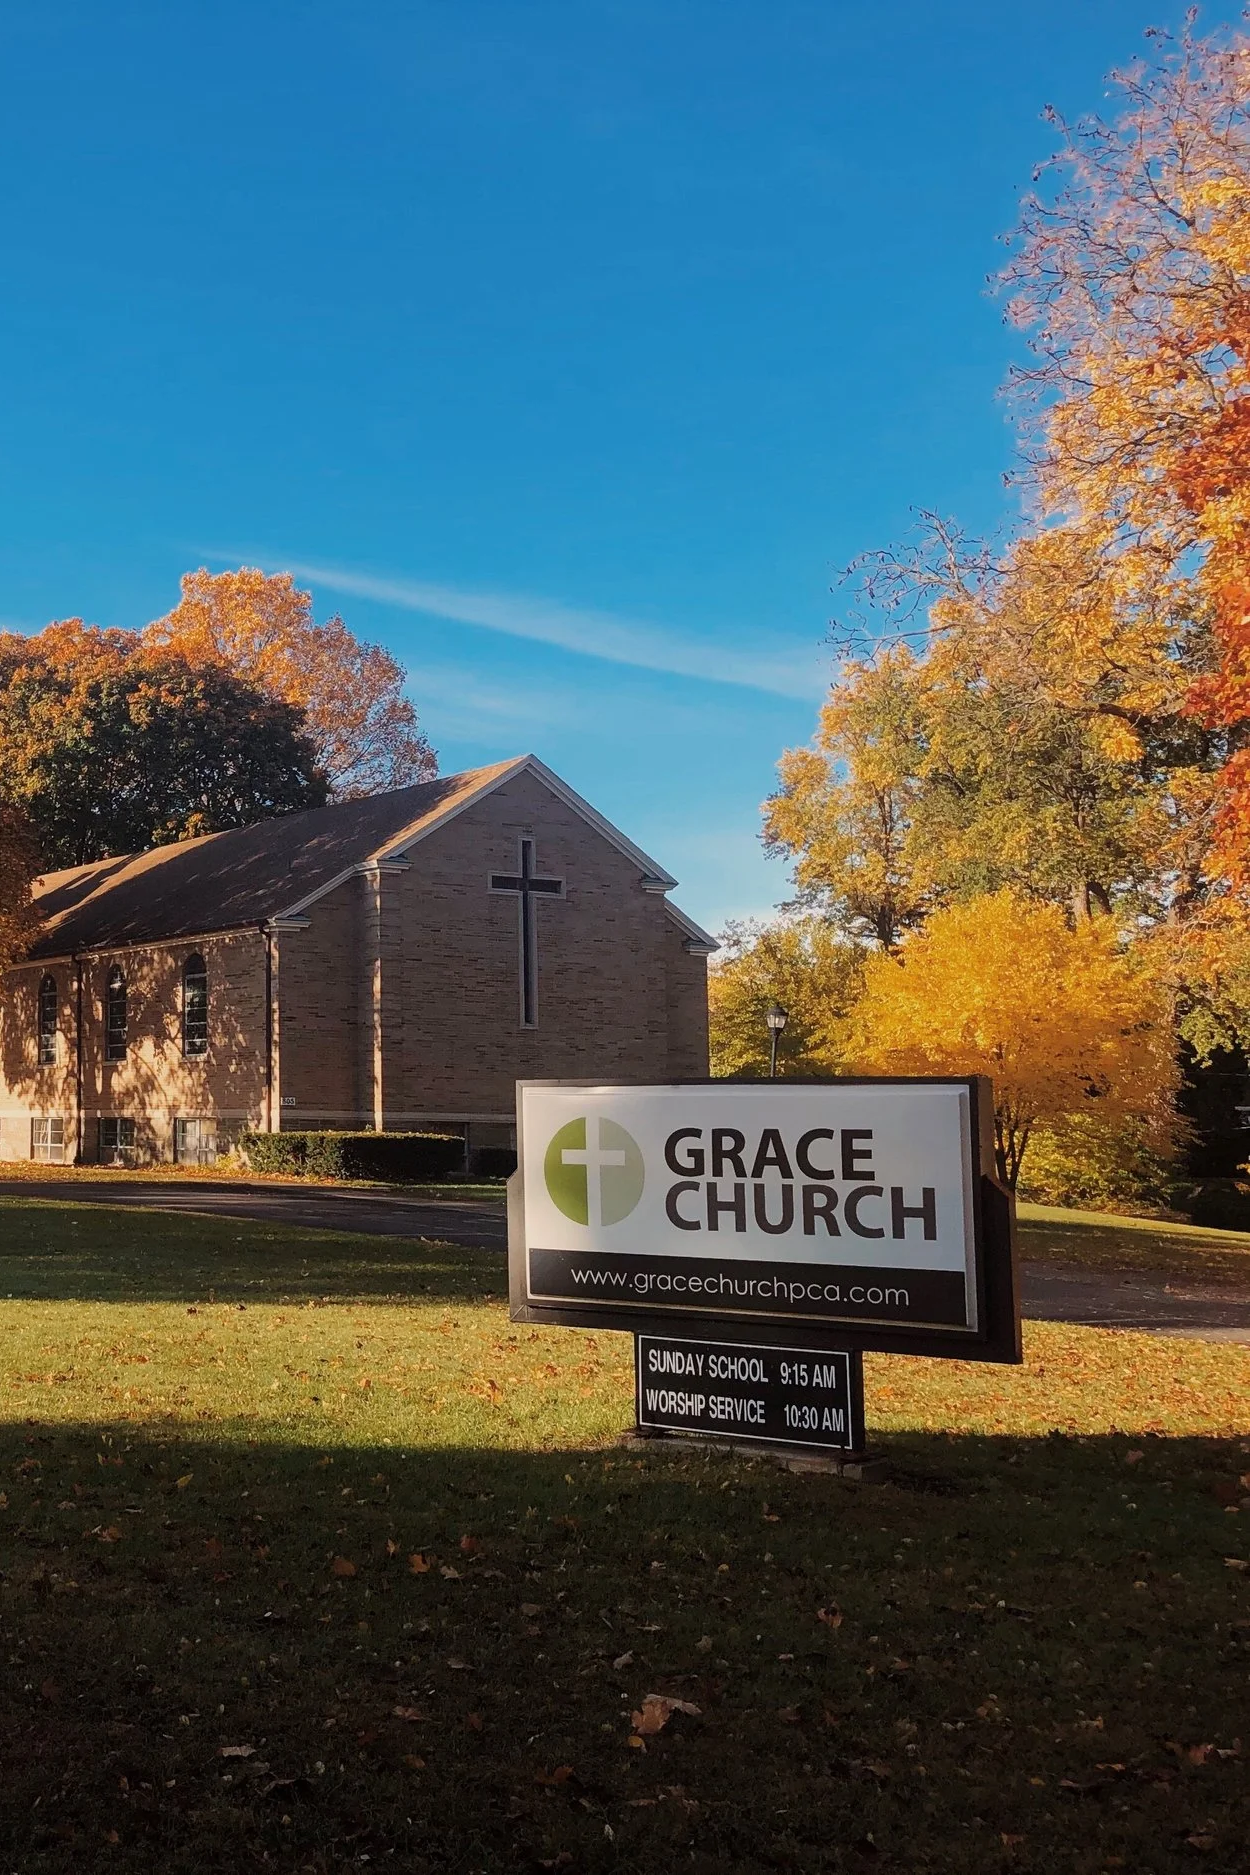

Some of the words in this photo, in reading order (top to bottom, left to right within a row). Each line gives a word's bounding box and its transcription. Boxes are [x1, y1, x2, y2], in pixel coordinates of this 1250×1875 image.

[664, 1127, 876, 1181] GRACE
[665, 1180, 937, 1241] CHURCH
[571, 1268, 910, 1306] www.gracechurchpca.com
[648, 1349, 705, 1377] SUNDAY
[708, 1354, 769, 1383] SCHOOL
[780, 1362, 809, 1387] 9:15
[812, 1364, 837, 1389] AM
[646, 1388, 706, 1417] WORSHIP
[709, 1395, 766, 1424] SERVICE
[784, 1404, 819, 1430] 10:30
[822, 1407, 845, 1433] AM
